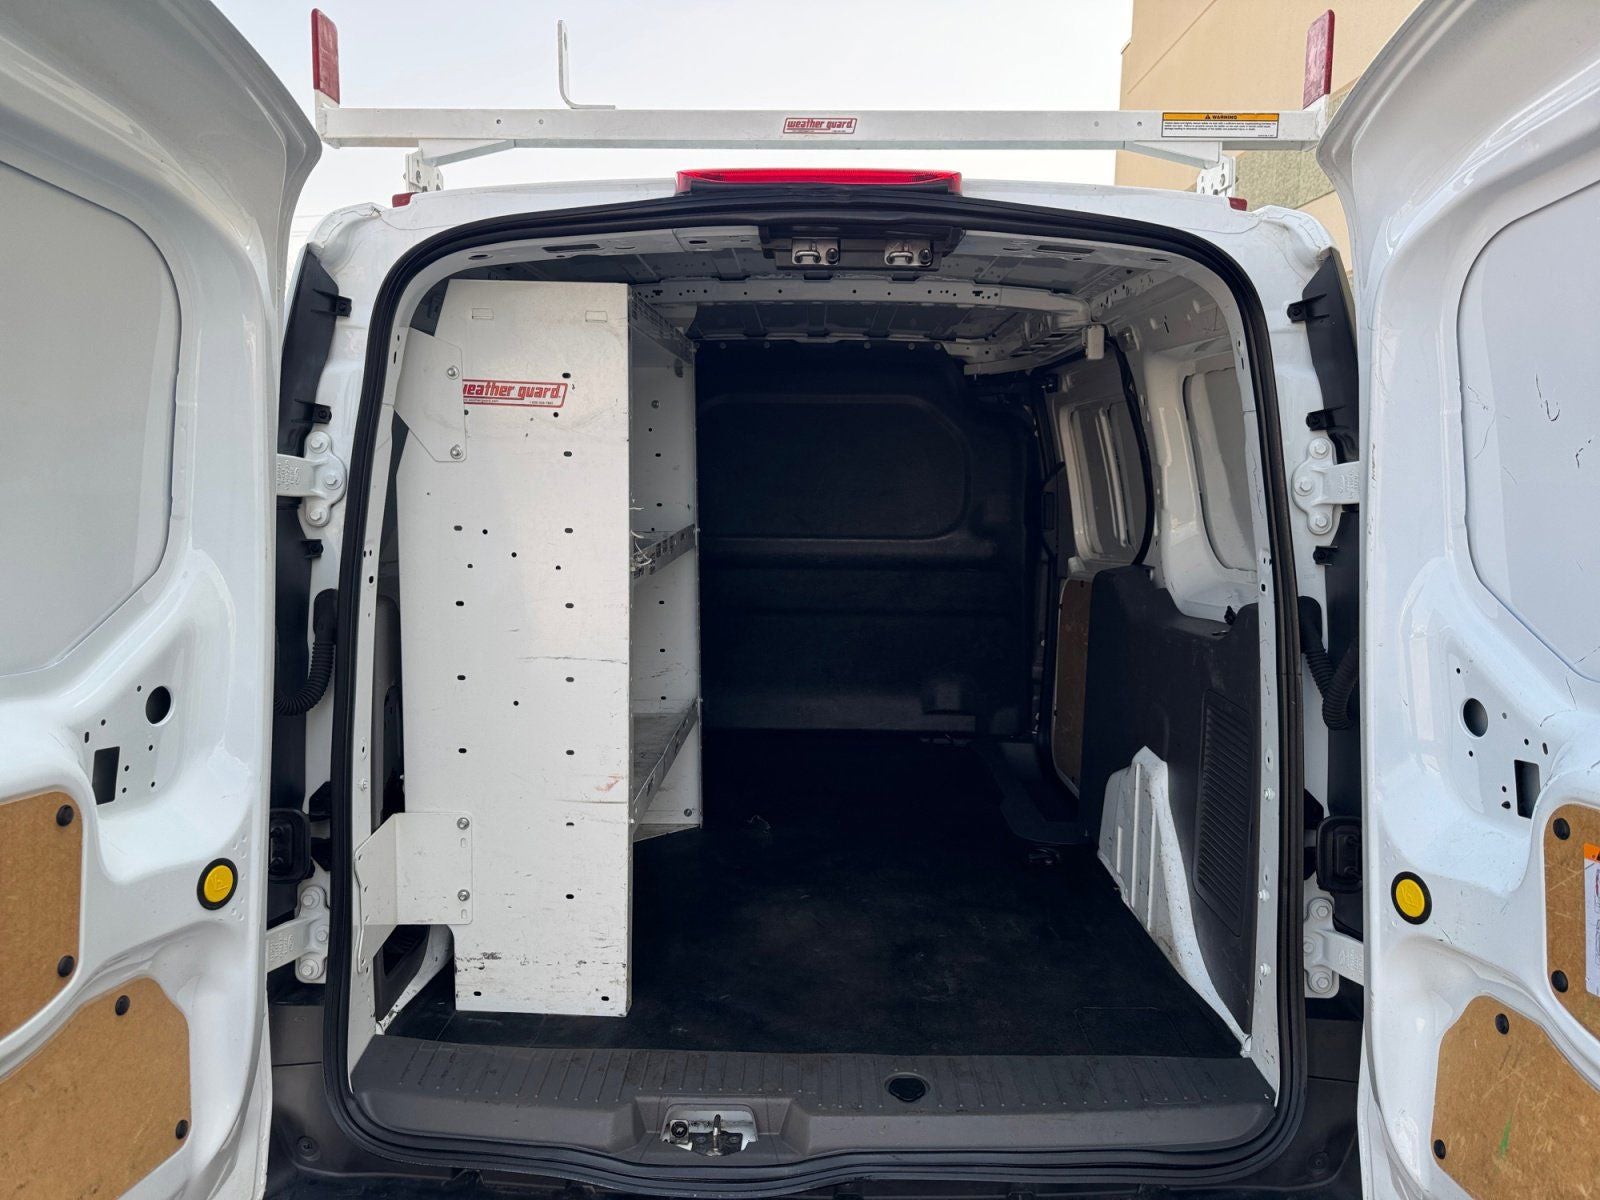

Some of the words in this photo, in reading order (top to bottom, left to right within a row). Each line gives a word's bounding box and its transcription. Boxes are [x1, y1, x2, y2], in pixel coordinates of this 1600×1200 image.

[787, 118, 825, 129] weather
[826, 118, 853, 130] guard
[517, 384, 560, 400] guard
